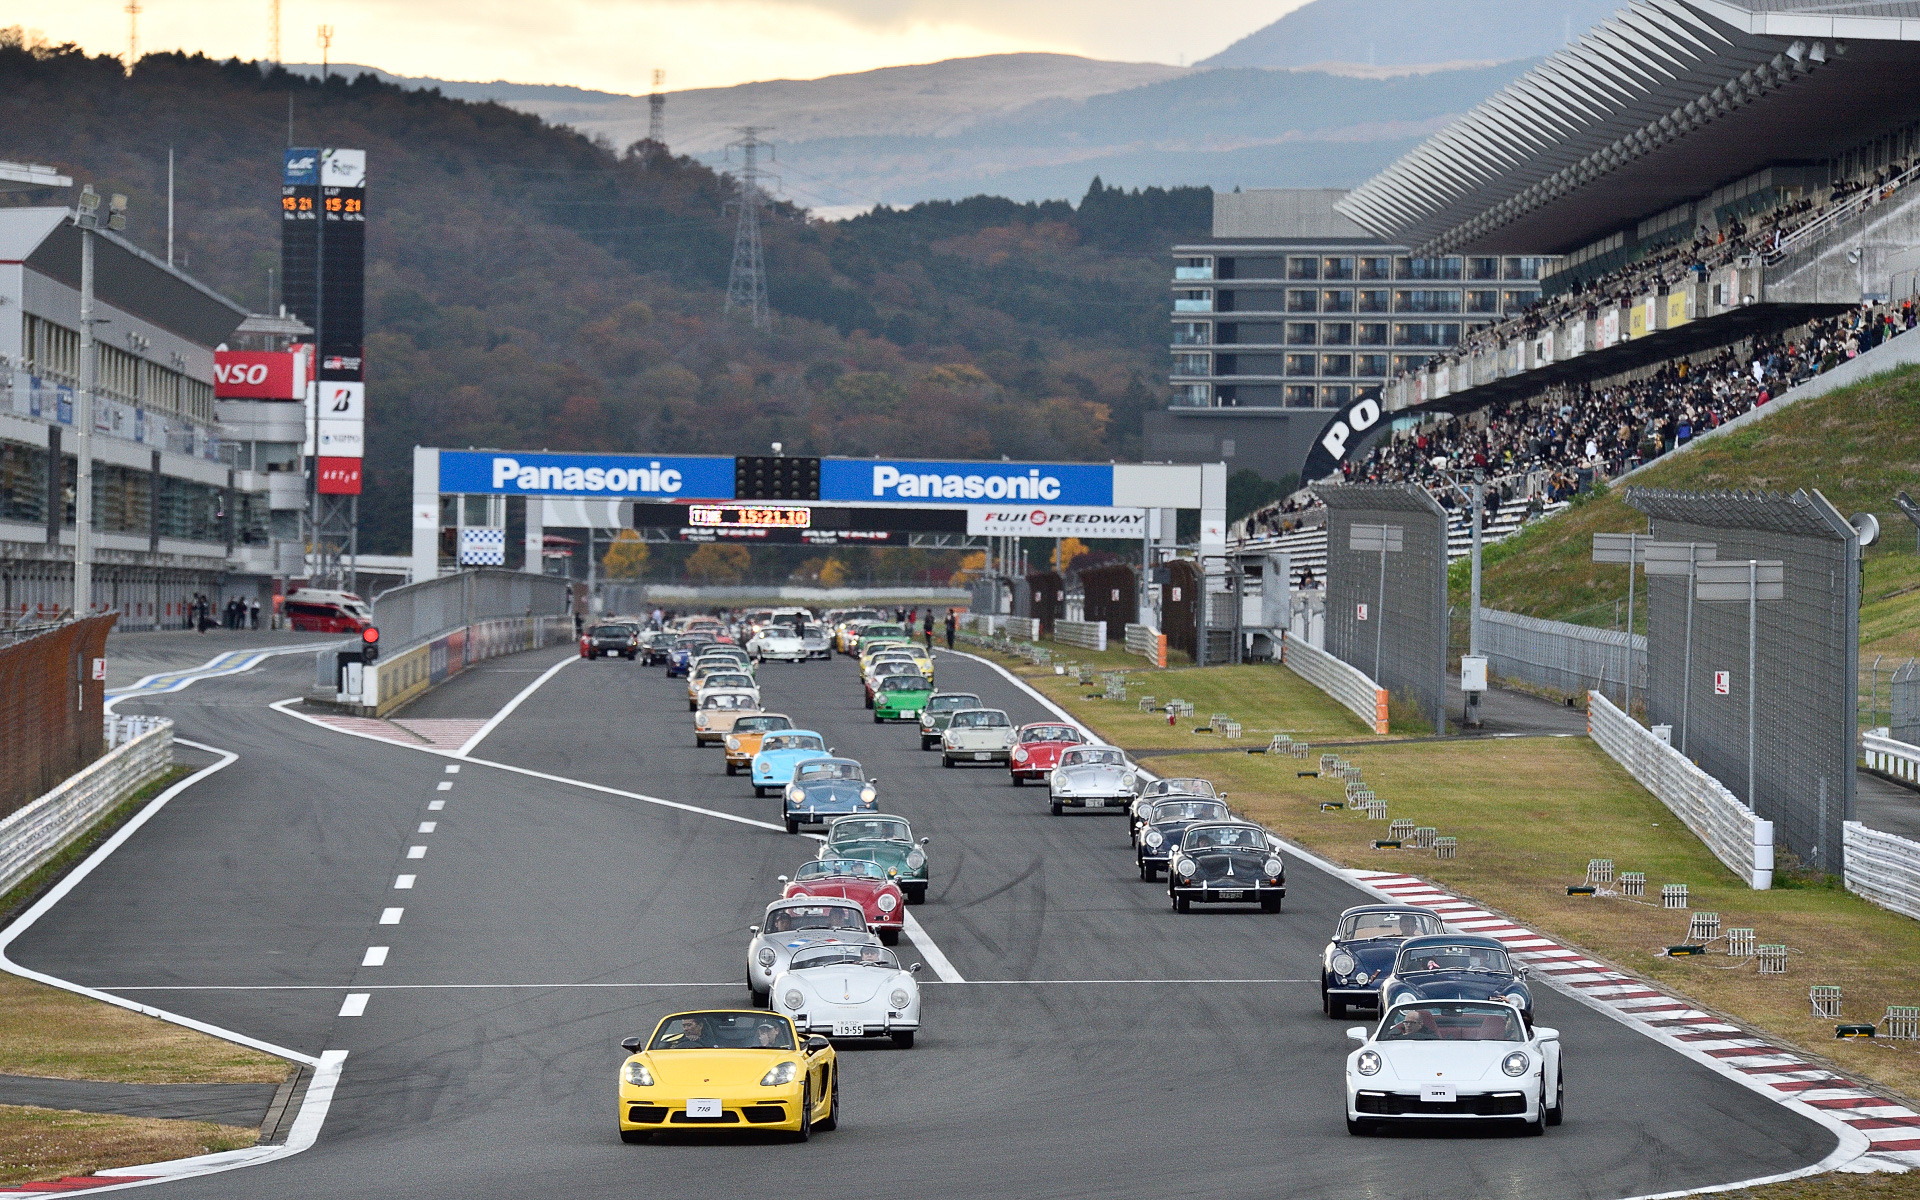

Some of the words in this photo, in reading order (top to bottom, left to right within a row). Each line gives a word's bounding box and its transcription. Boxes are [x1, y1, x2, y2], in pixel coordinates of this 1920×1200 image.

[282, 197, 297, 210] 15
[298, 197, 313, 210] 21
[325, 197, 342, 211] 15
[344, 198, 361, 212] 21
[492, 457, 683, 493] Panasonic
[873, 465, 1061, 500] Panasonic
[985, 512, 1028, 523] FUJI
